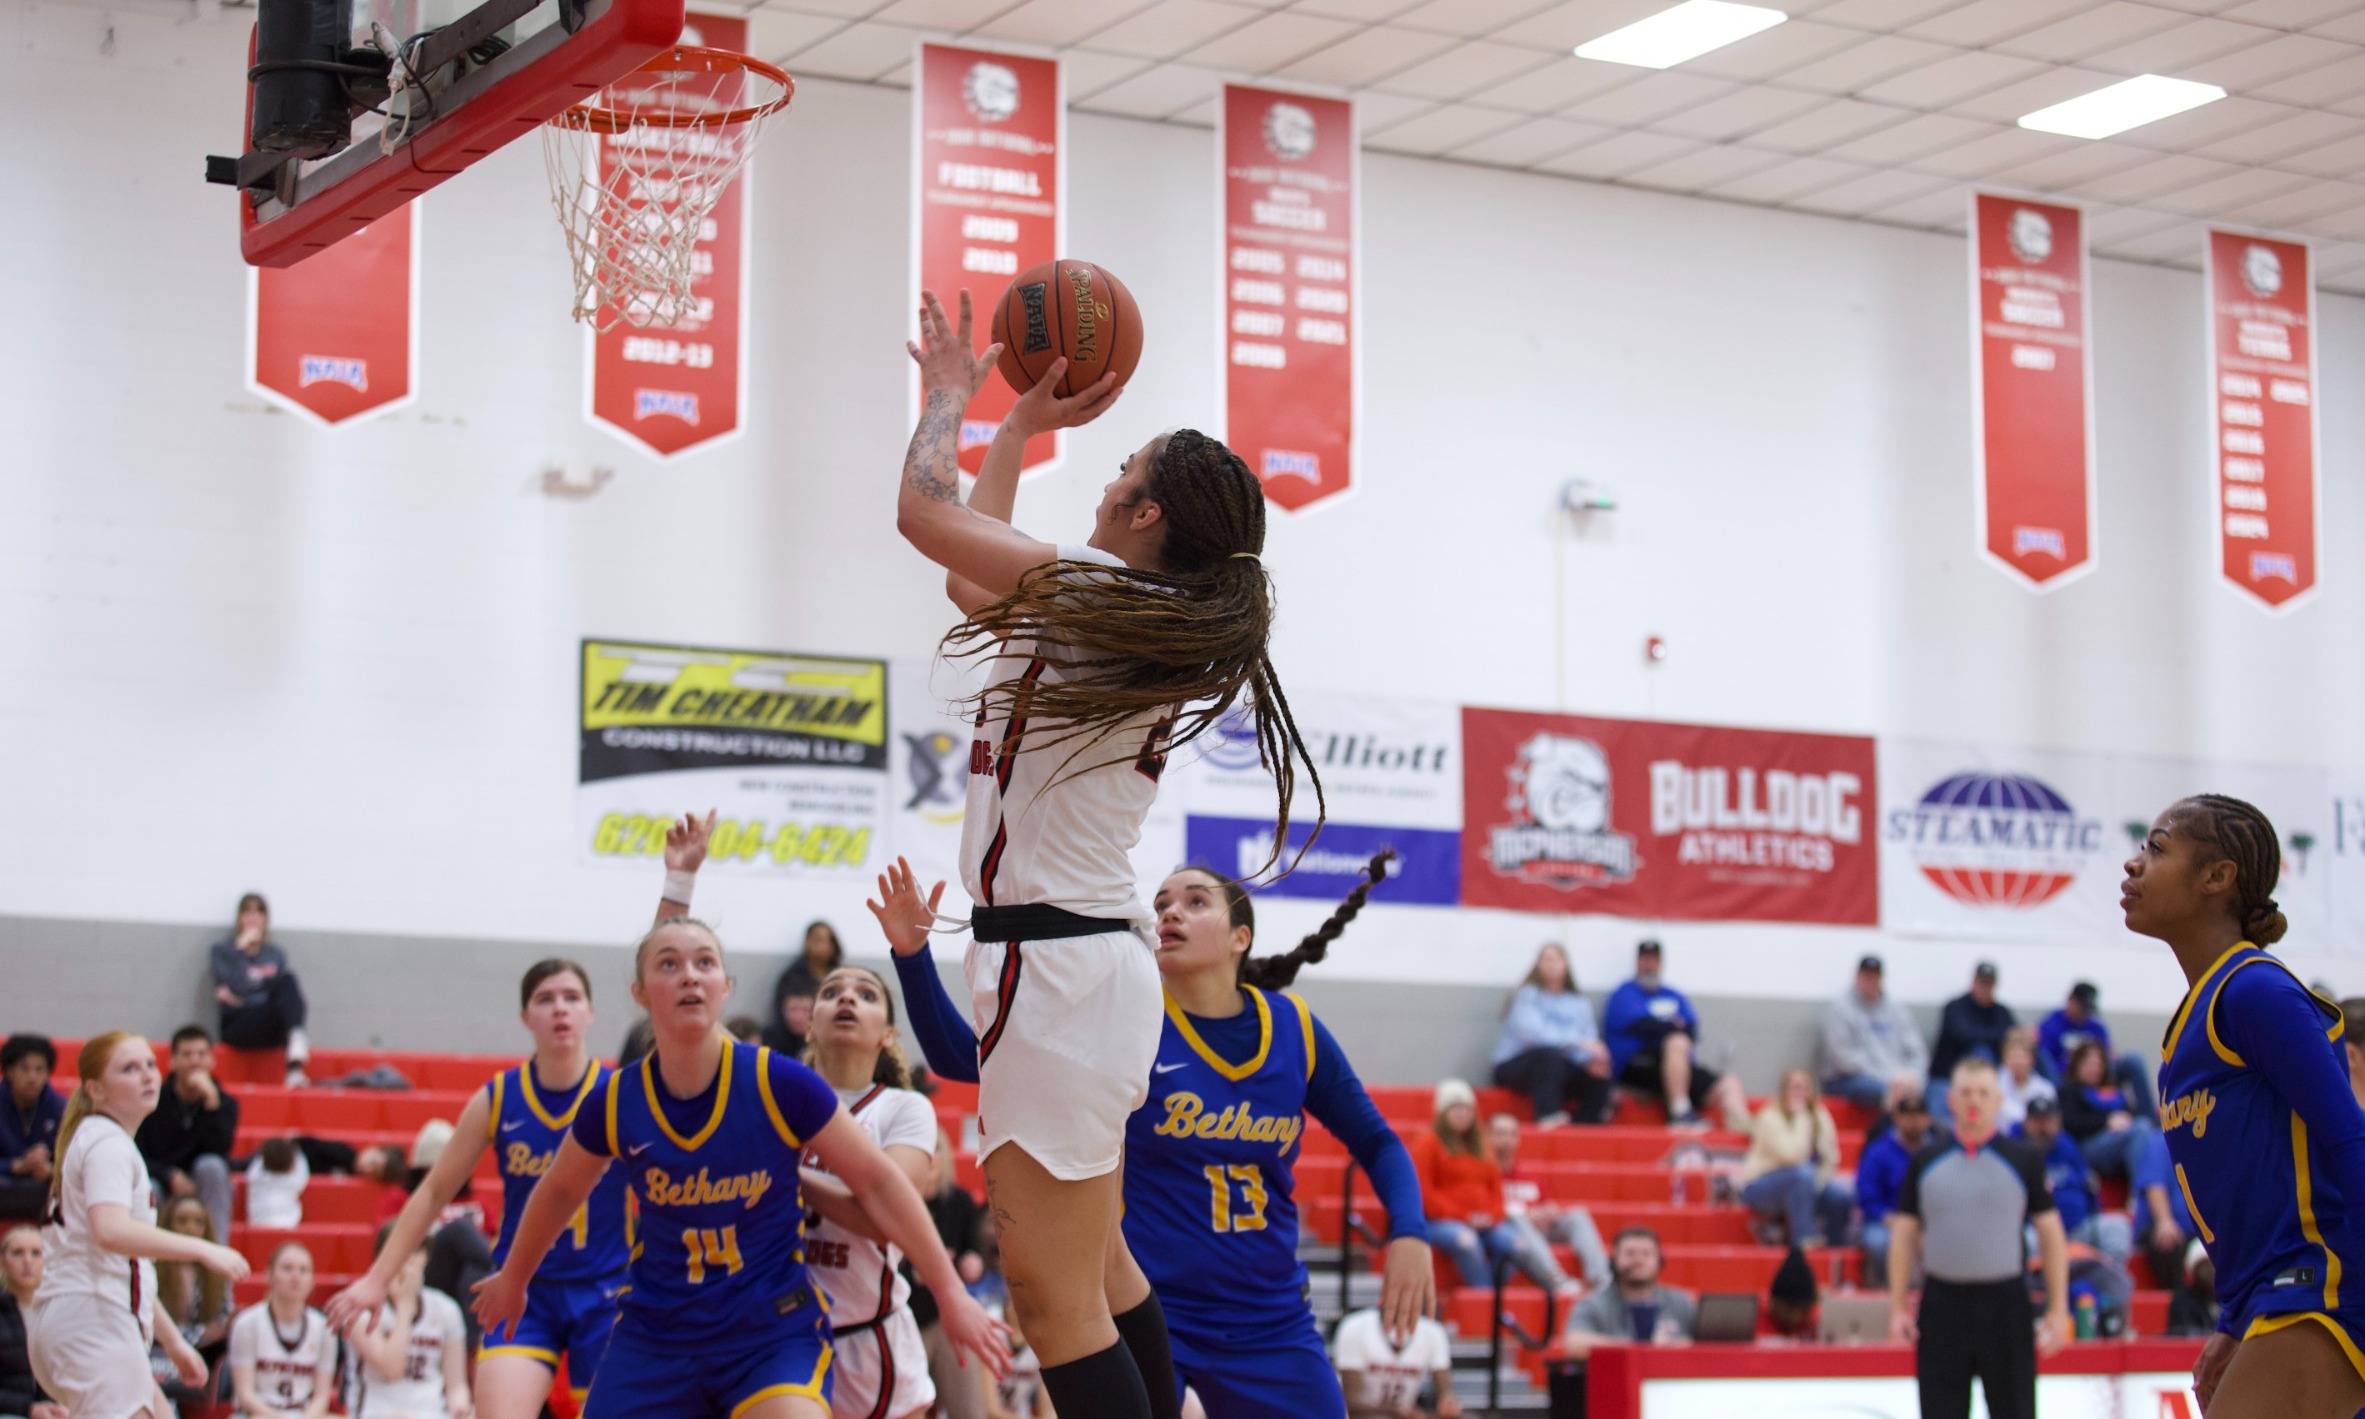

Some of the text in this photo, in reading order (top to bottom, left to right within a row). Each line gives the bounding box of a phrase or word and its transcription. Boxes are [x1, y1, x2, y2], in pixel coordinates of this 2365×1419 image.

[938, 162, 1042, 196] FOOTBALL
[1252, 199, 1328, 232] SOCCER
[1022, 284, 1050, 350] NAIA
[1066, 268, 1097, 362] SPALDING
[593, 683, 874, 728] TIM CHEATHAM
[601, 727, 867, 764] CONSTRUCTION LLC
[1649, 758, 1864, 845] BULLDOG
[593, 813, 873, 867] 62004-6424
[1677, 830, 1835, 873] ATHLETICS
[1887, 809, 2103, 852] STEAMATIC
[1153, 1090, 1301, 1158] Bethany
[645, 1165, 773, 1210] Bethany
[1203, 1163, 1269, 1234] 13
[682, 1224, 745, 1285] 14
